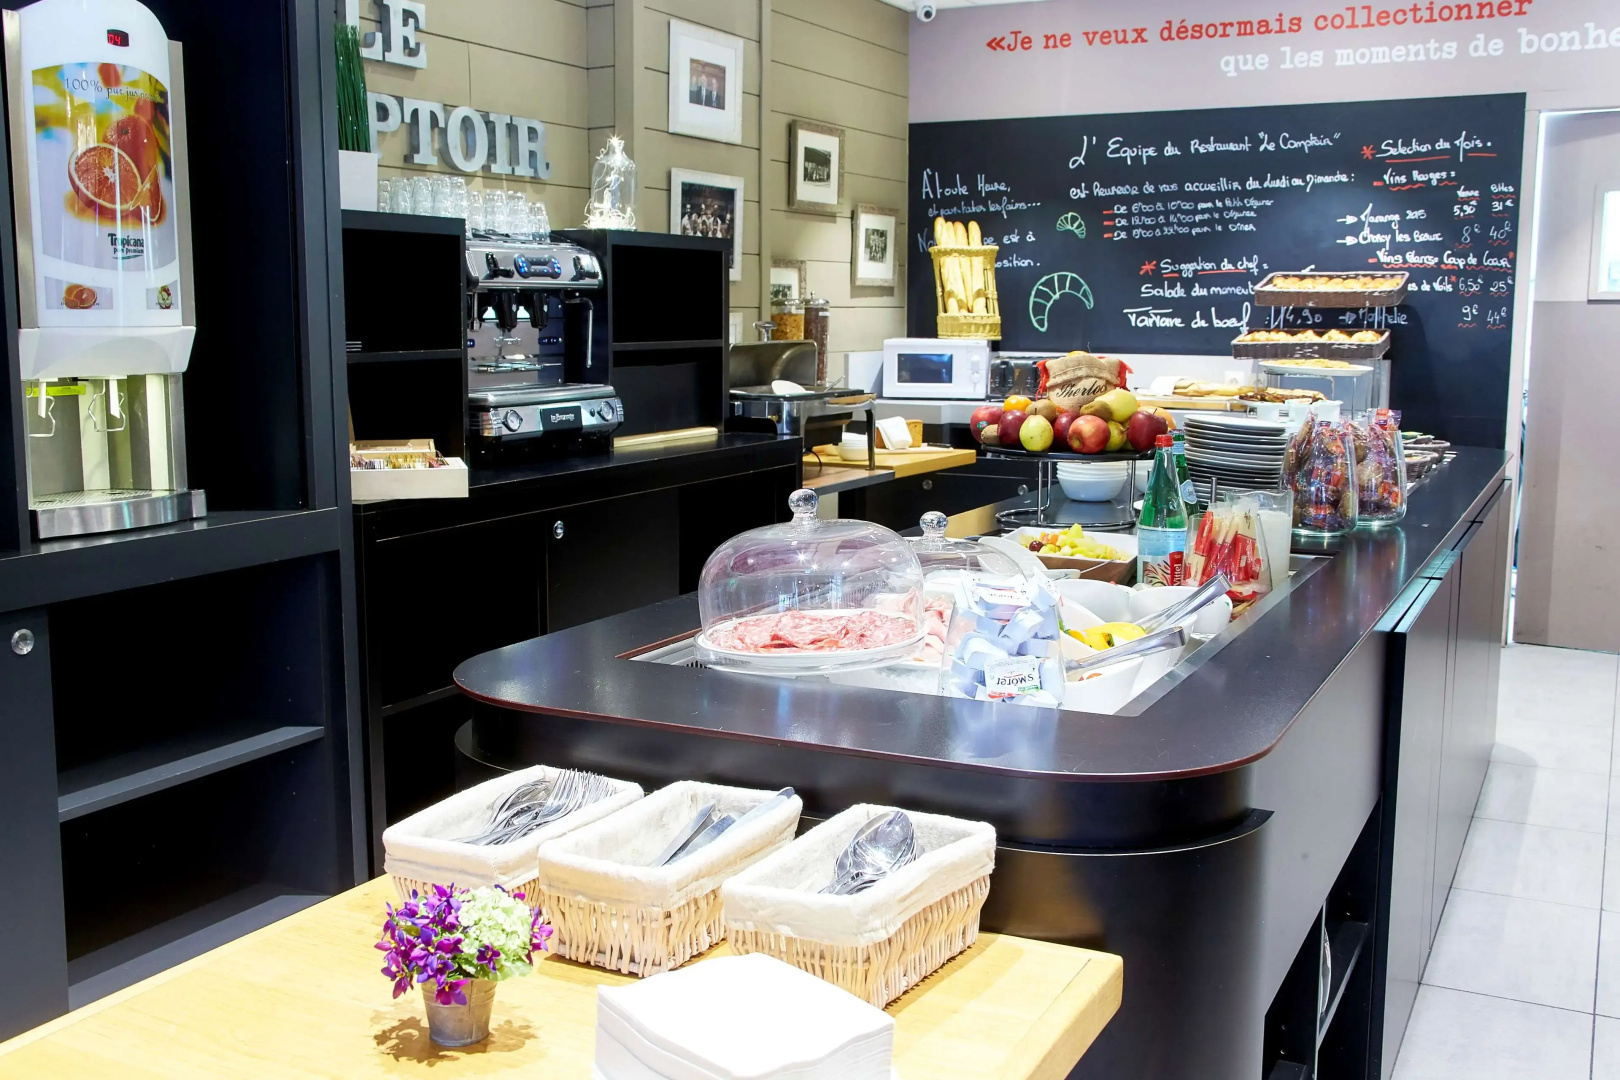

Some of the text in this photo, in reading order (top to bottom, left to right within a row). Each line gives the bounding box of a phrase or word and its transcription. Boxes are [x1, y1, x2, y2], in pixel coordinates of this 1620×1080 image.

[1043, 32, 1072, 50] ne
[1082, 26, 1148, 47] veux
[1159, 13, 1302, 42] désormais
[1314, 0, 1533, 31] collectionner
[1220, 52, 1269, 77] que
[1280, 46, 1324, 68] les
[1334, 38, 1457, 66] moments
[1468, 33, 1504, 58] de
[65, 77, 103, 93] 100%
[105, 86, 123, 100] pur
[366, 91, 551, 180] PTOIR
[1435, 138, 1451, 150] du
[1164, 140, 1181, 156] du
[1190, 136, 1251, 154] Restaurant
[1383, 168, 1407, 185] Vins
[1069, 182, 1089, 199] est
[1143, 181, 1155, 194] de
[1246, 176, 1262, 190] du
[1263, 173, 1290, 188] Lundi
[1291, 177, 1305, 187] au
[1113, 204, 1128, 214] De
[1215, 198, 1223, 208] le
[1114, 217, 1129, 227] De
[1213, 211, 1220, 219] le
[108, 232, 144, 249] Tropicana
[1002, 228, 1020, 244] est
[1026, 230, 1036, 242] à
[1113, 230, 1128, 240] De
[1215, 223, 1222, 232] le
[1396, 230, 1411, 242] les
[1221, 257, 1235, 270] du
[1236, 254, 1259, 275] chef
[1376, 247, 1403, 263] Vins
[1467, 253, 1478, 265] de
[1140, 280, 1256, 298] Salade du moment
[1123, 306, 1185, 328] Tartare
[1191, 310, 1208, 328] de
